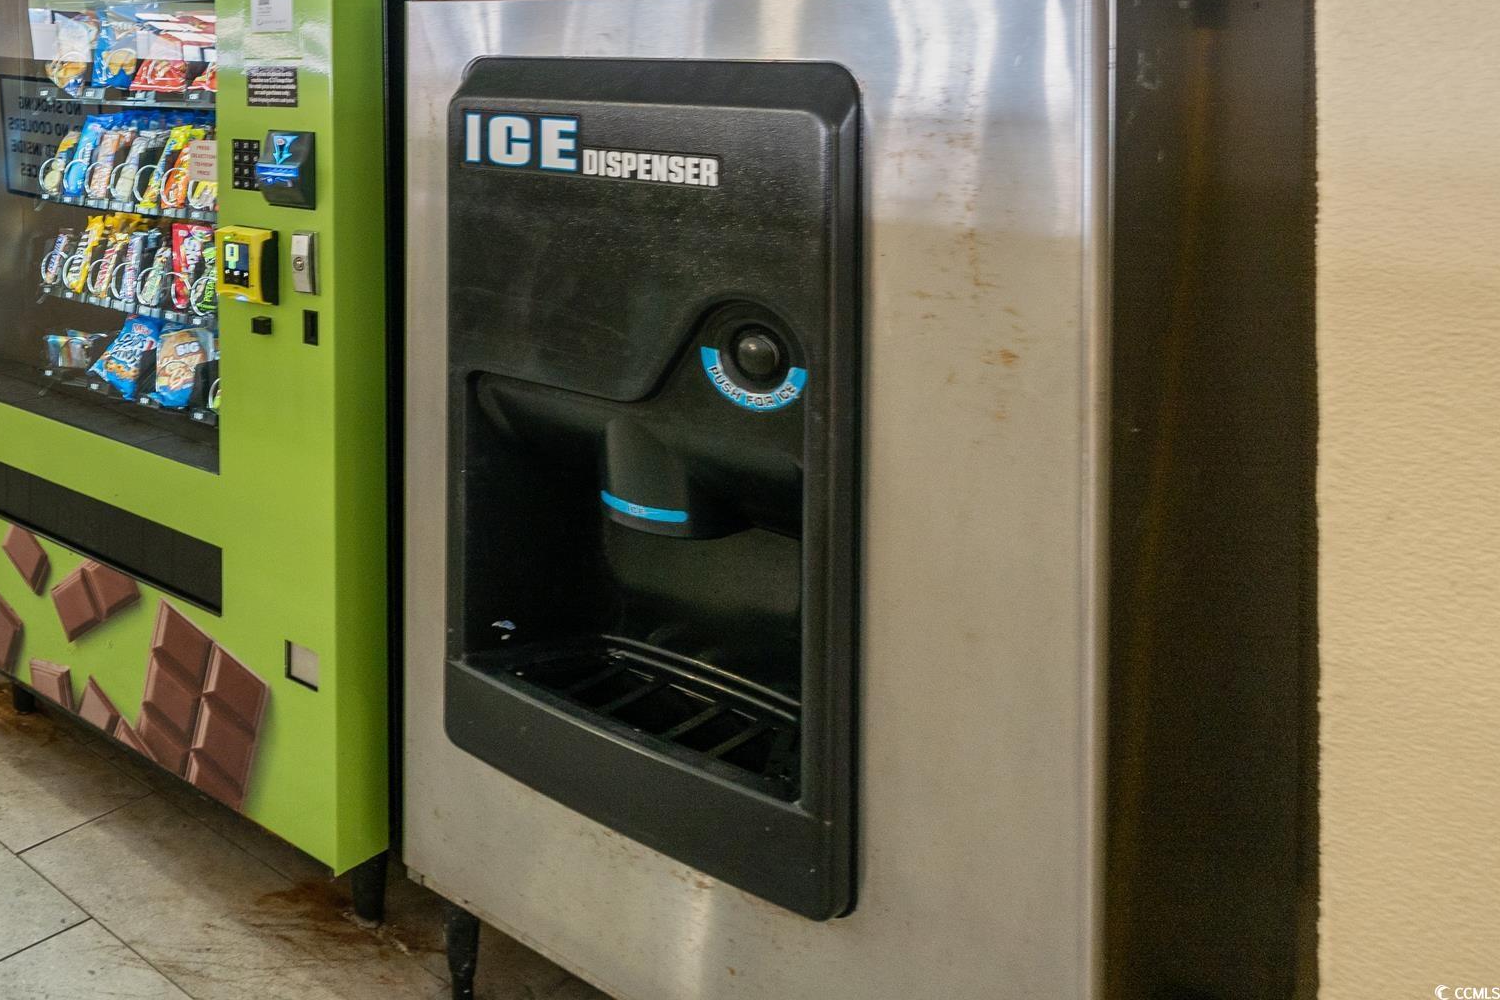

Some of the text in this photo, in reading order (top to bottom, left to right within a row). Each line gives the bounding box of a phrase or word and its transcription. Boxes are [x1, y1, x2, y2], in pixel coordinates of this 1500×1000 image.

[466, 113, 719, 187] ICE DISPENSER
[709, 366, 795, 406] PUSH FOR ICE
[627, 504, 644, 515] ICE
